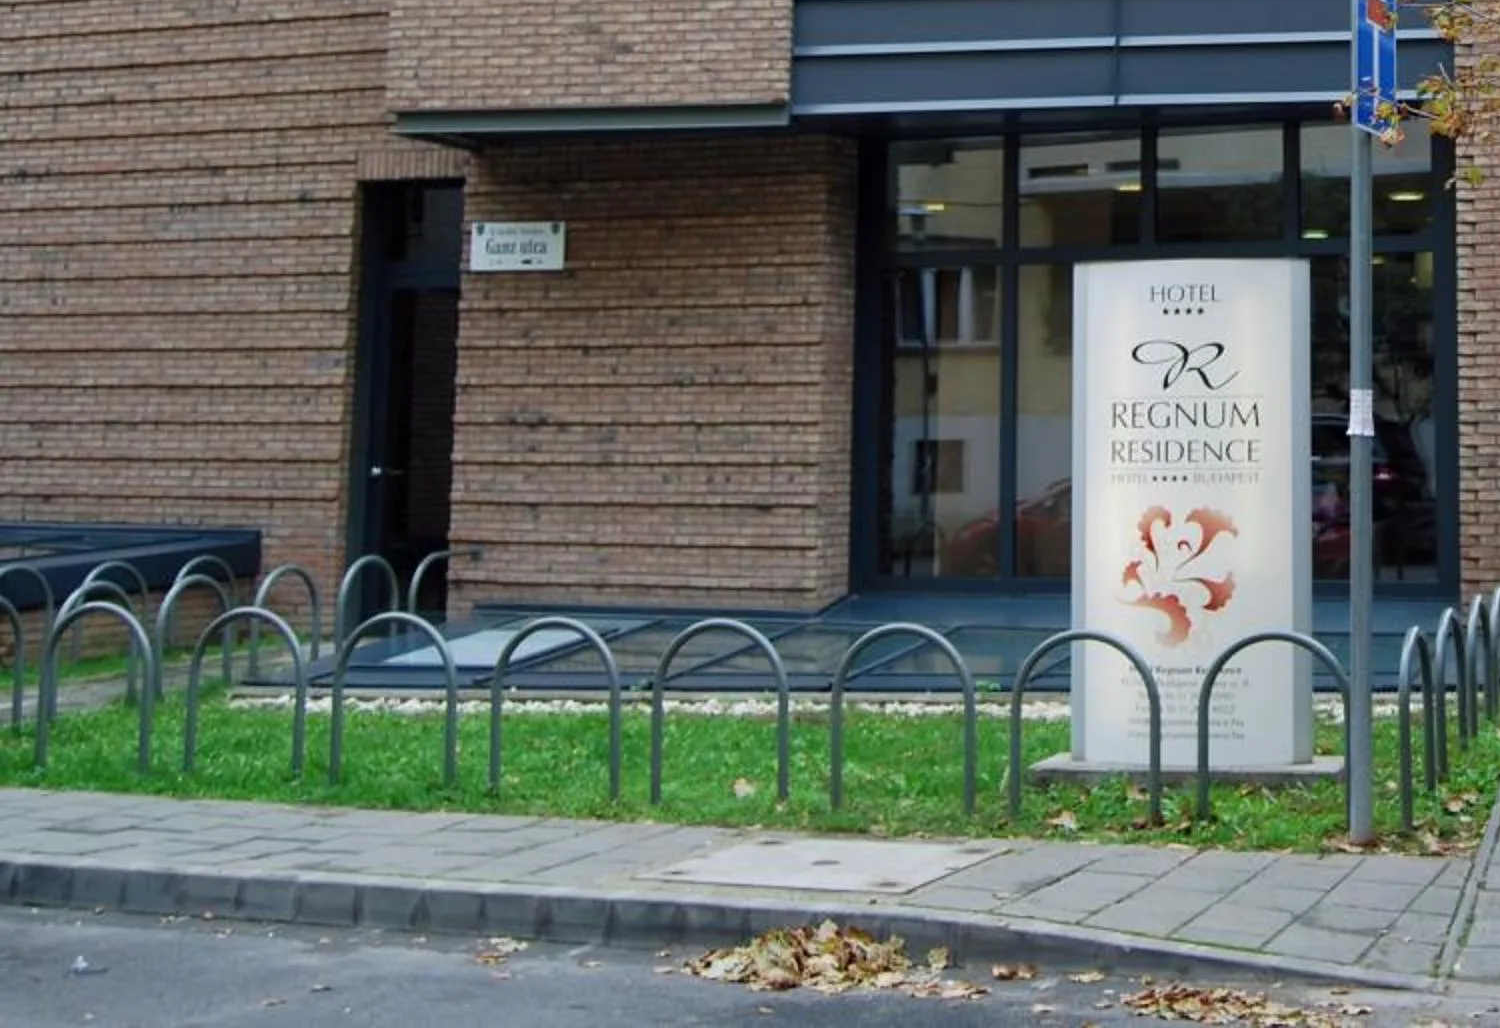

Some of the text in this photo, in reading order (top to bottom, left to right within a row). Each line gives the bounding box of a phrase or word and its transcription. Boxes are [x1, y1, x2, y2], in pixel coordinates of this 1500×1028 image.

[1150, 283, 1222, 303] HOTEL
[1111, 402, 1261, 429] REGNUM
[1111, 439, 1261, 463] RESIDENCE
[1193, 472, 1260, 484] BUDAPEST
